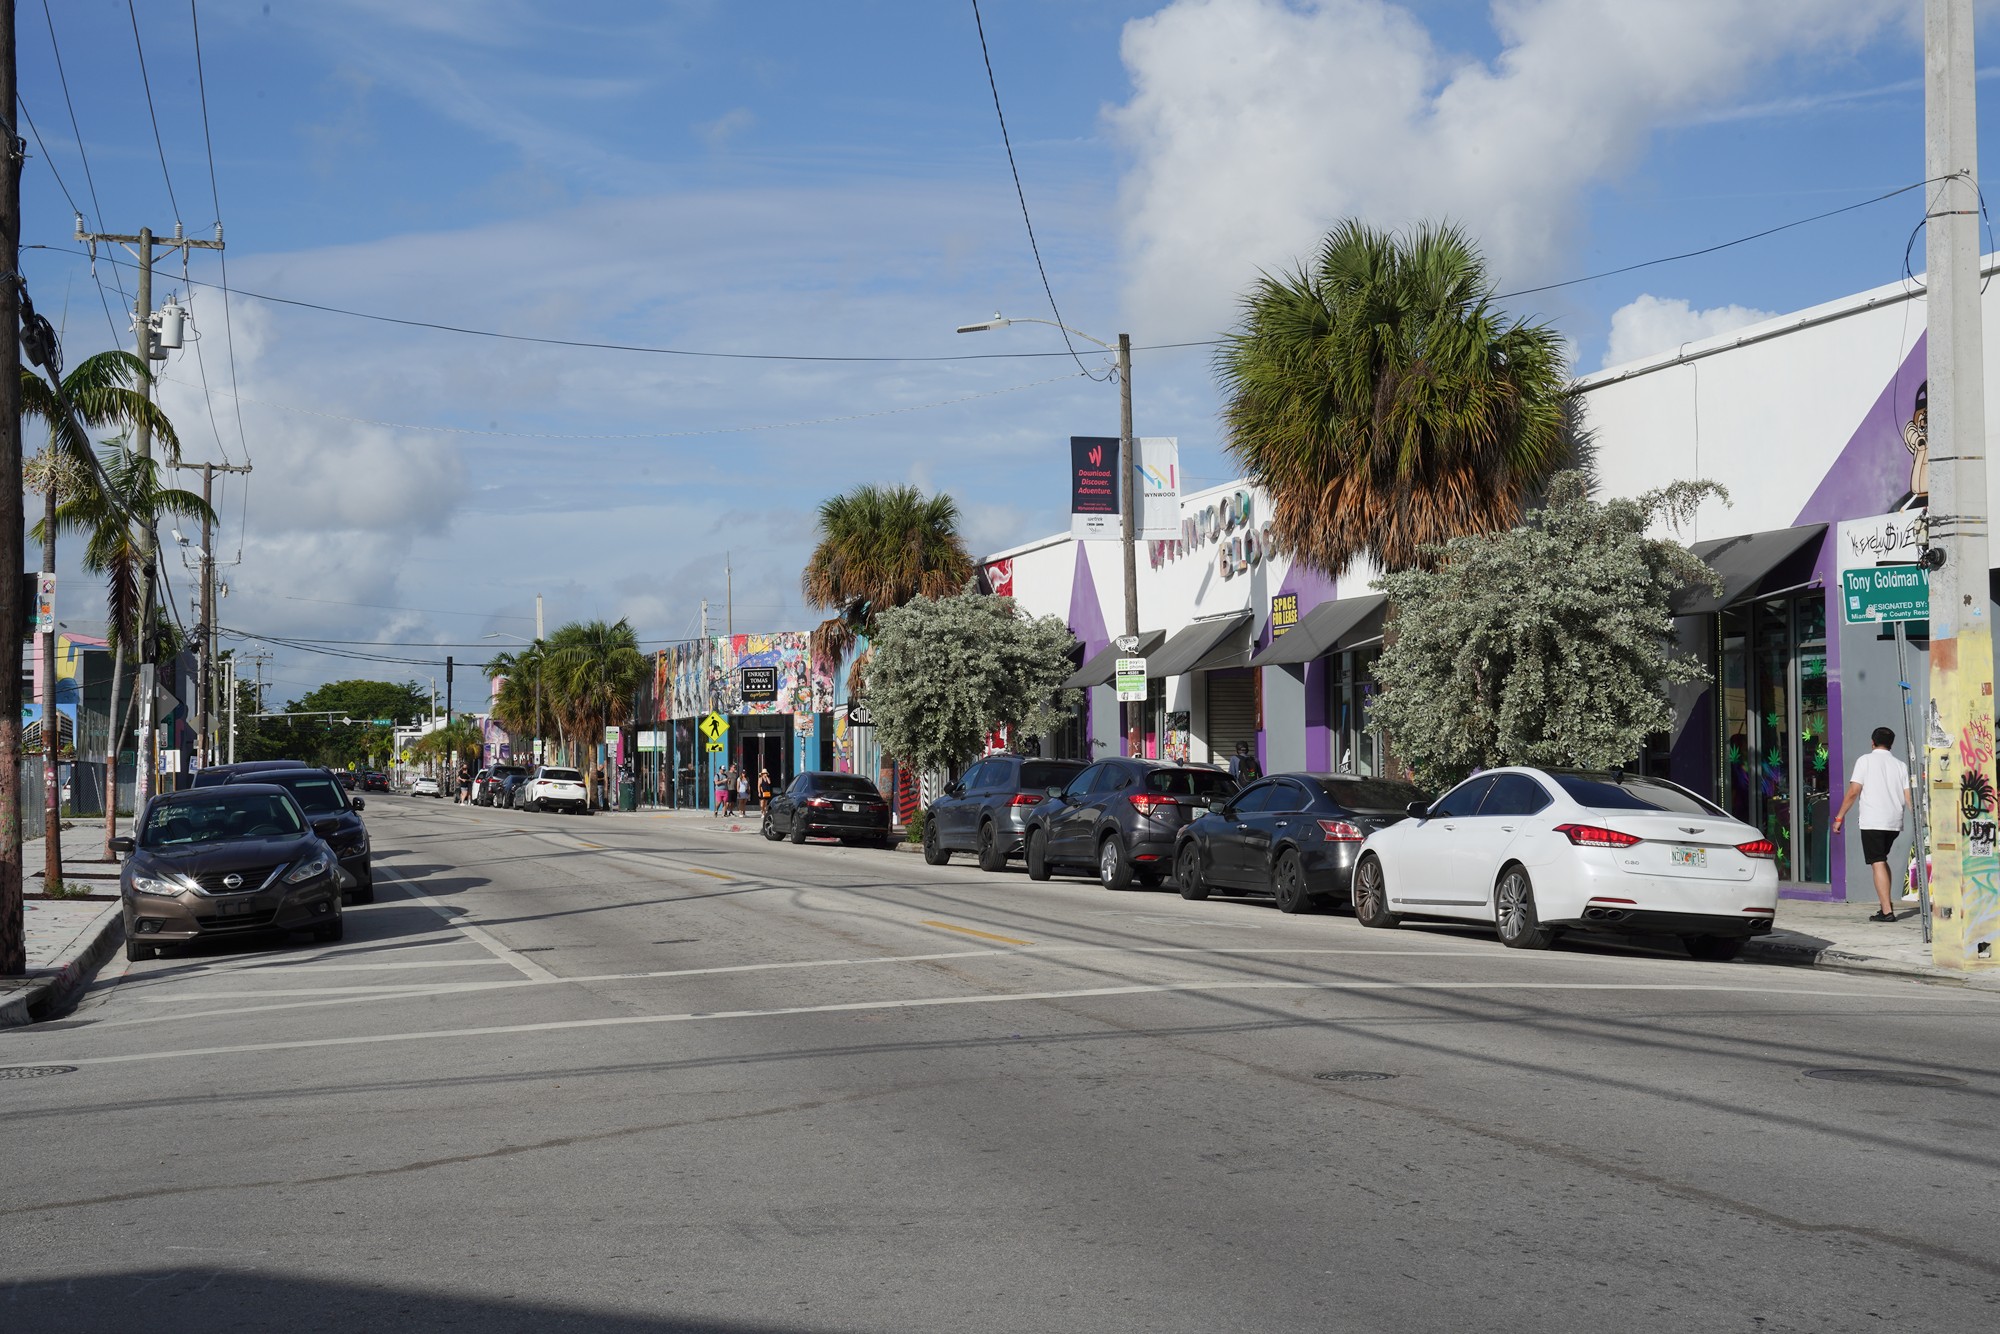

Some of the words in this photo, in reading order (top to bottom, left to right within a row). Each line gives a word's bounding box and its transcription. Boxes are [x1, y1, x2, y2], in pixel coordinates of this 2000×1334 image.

[1219, 520, 1277, 578] BLOC
[1847, 573, 1871, 593] Tony
[1874, 570, 1919, 588] Goldman
[1273, 596, 1296, 612] SPACE
[1868, 602, 1913, 611] DESIGNATED
[1272, 611, 1283, 625] FOR
[1283, 610, 1298, 624] LEASE
[1889, 610, 1911, 618] County
